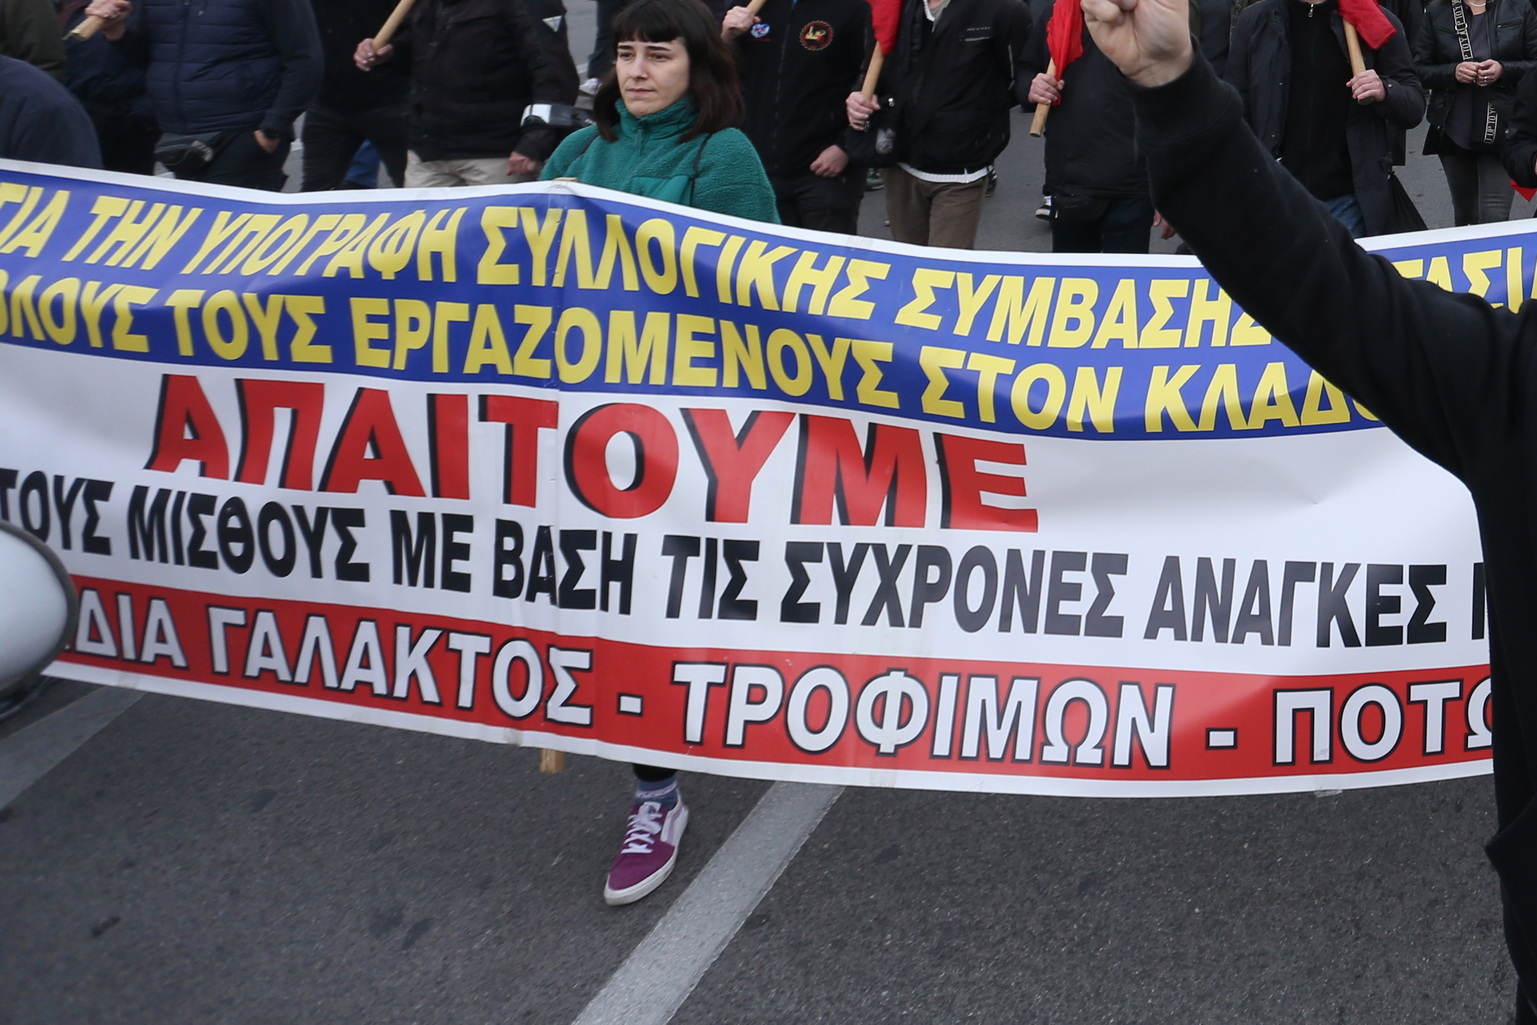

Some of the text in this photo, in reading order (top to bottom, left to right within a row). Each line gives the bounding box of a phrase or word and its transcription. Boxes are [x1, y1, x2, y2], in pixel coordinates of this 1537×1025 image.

[61, 195, 204, 270] ΤΗΝ
[179, 209, 461, 282] ΥΠΟΓΡΑΦΗ
[478, 207, 891, 321] ΣΥΛΛΟΓΙΚΗΣ
[0, 269, 1380, 434] ΛΟΥΣ ΤΟΥΣ ΕΡΓΑΖΟΜΕΝΟΥΣ ΣΤΟΝ ΚΛΑΔ
[145, 373, 1038, 533] ΑΠΑΙΤΟΥΜΕ
[128, 484, 370, 582] ΜΙΣΘΟΥΣ
[389, 509, 473, 594] ΜΕ
[493, 518, 638, 616] ΒΑΣΗ
[661, 534, 762, 622] ΤΙΣ
[781, 541, 1129, 639] ΣΥΧΡΟΝΕΣ
[1143, 554, 1448, 649] ΑΝΑΓΚΕΣ
[206, 606, 592, 728] ΓΑΛΑΚΤΟΣ
[616, 691, 644, 717] -
[673, 662, 1175, 770] ΤΡΟΦΙΜΩΝ
[1206, 726, 1239, 751] -
